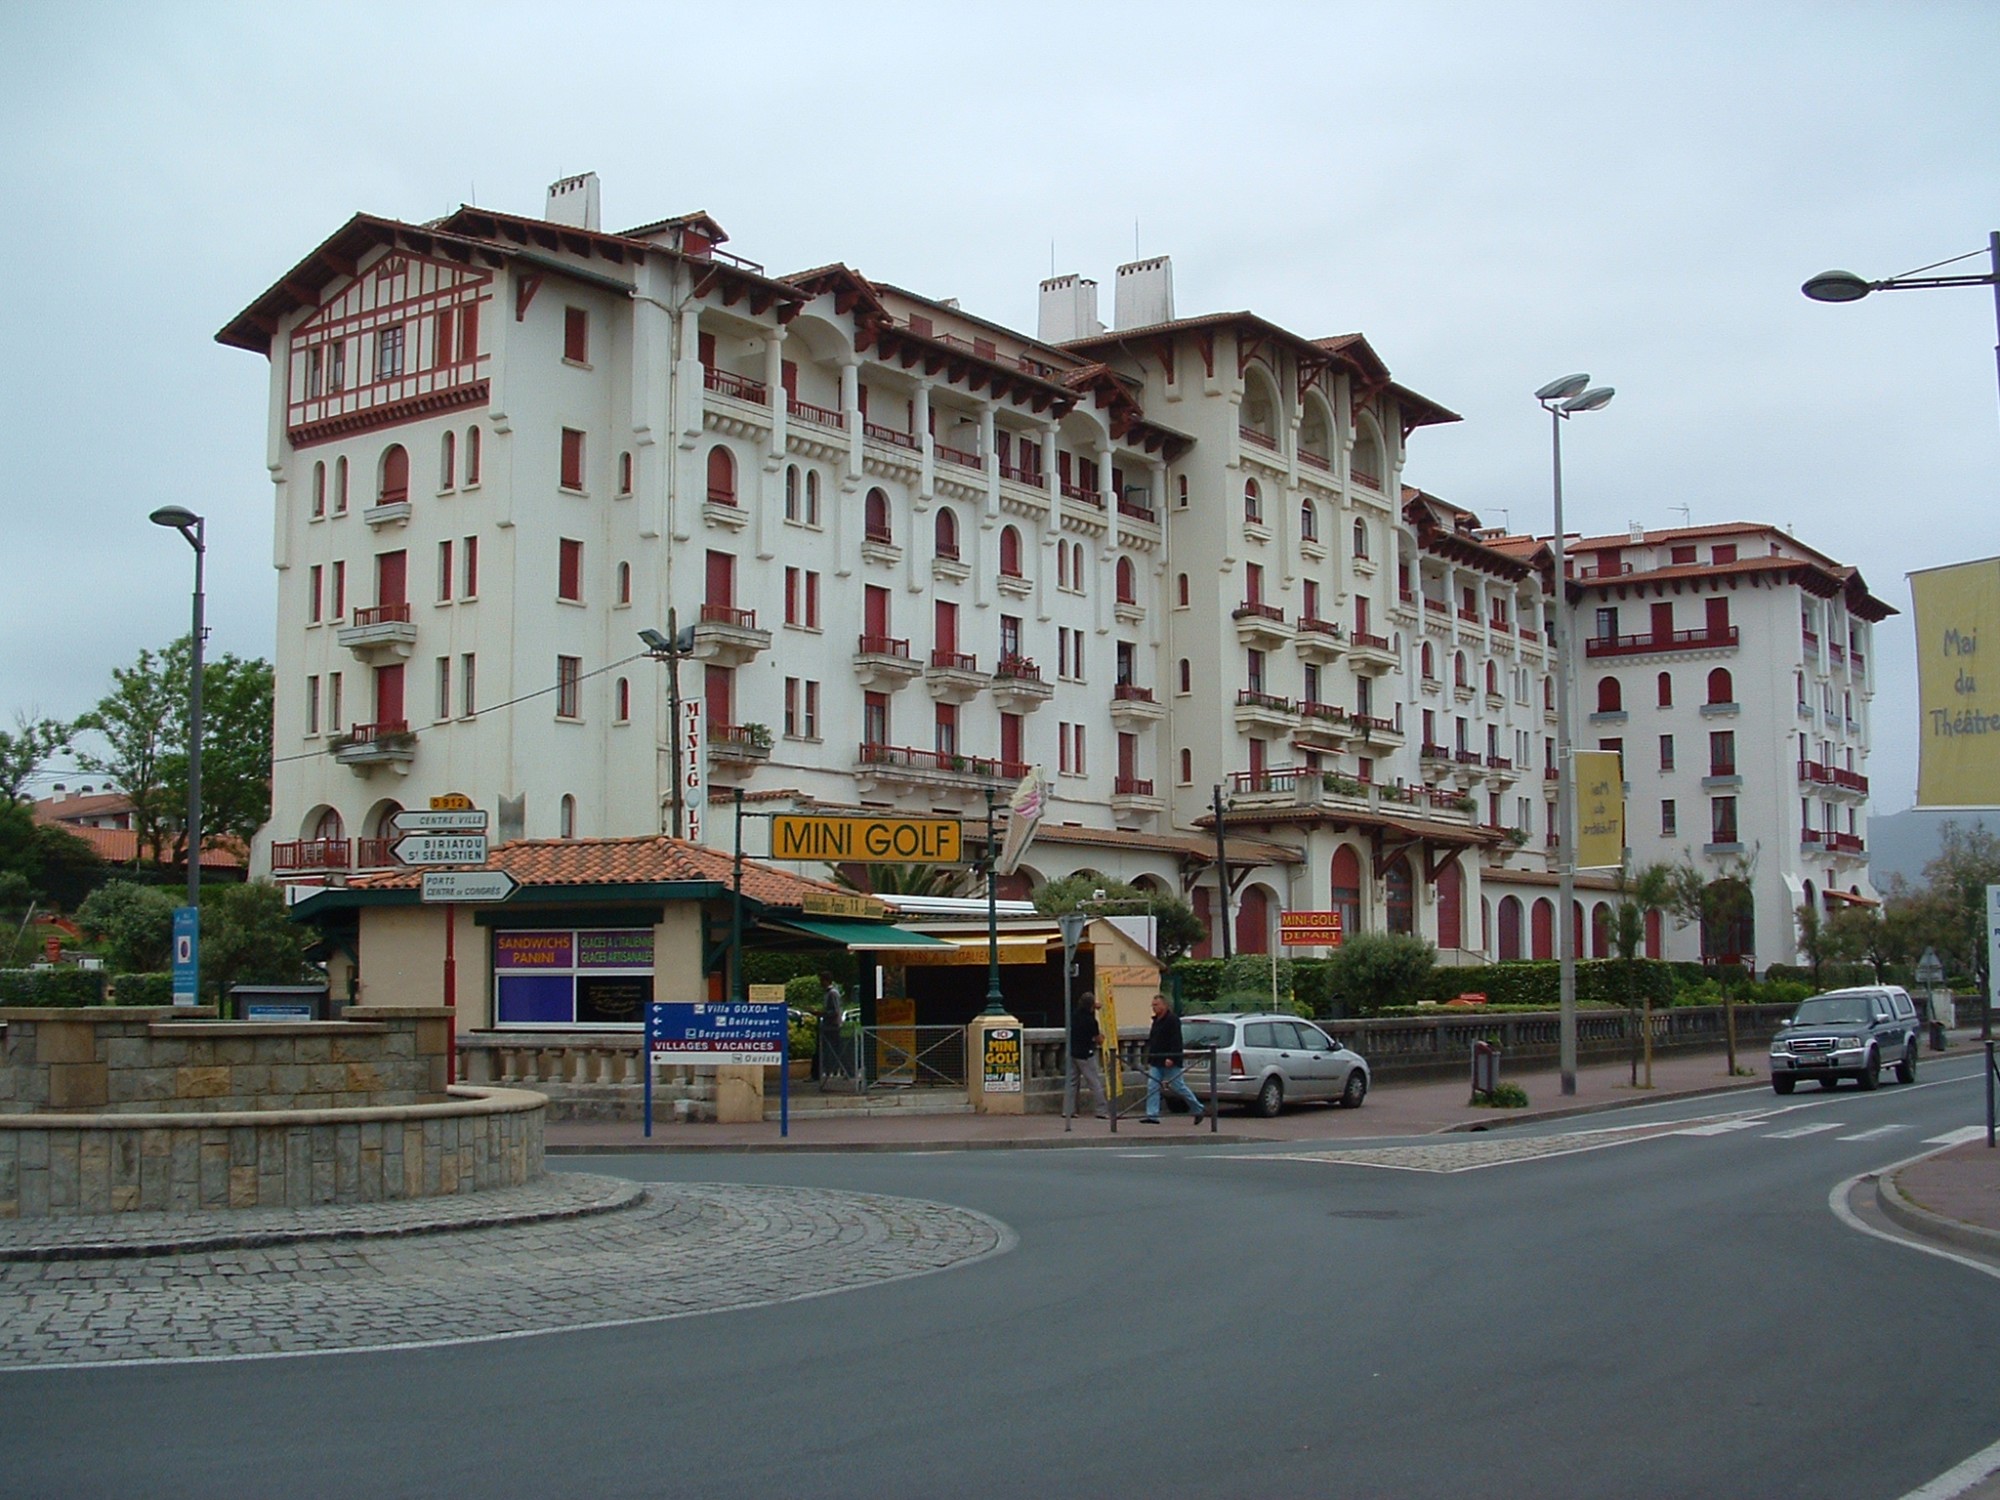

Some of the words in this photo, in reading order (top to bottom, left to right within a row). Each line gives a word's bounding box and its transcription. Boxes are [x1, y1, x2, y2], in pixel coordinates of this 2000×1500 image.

[1944, 628, 1977, 657] Mai
[1954, 668, 1976, 695] du
[1929, 708, 2000, 737] Théâtre
[442, 799, 464, 808] 912
[420, 816, 453, 825] CENTRE
[458, 815, 483, 824] VILLE
[424, 839, 482, 849] BIRIATOU
[783, 822, 851, 854] MINI
[865, 824, 950, 857] GOLF
[423, 848, 482, 860] SÉBASTIEN
[426, 877, 455, 885] PORTS
[426, 888, 455, 896] CENTRE
[1282, 914, 1339, 926] MINI-GOLF
[499, 936, 570, 949] SANDWICHS
[580, 937, 606, 948] GLACES
[513, 952, 555, 963] PANINI
[581, 951, 607, 963] GLACES
[707, 1005, 730, 1013] Villa
[734, 1005, 768, 1013] GOXOA
[728, 1017, 770, 1026] Bellevue
[655, 1042, 709, 1051] VILLAGES
[715, 1042, 774, 1051] VACANCES
[989, 1041, 1017, 1052] MINI
[985, 1052, 1019, 1064] GOLF
